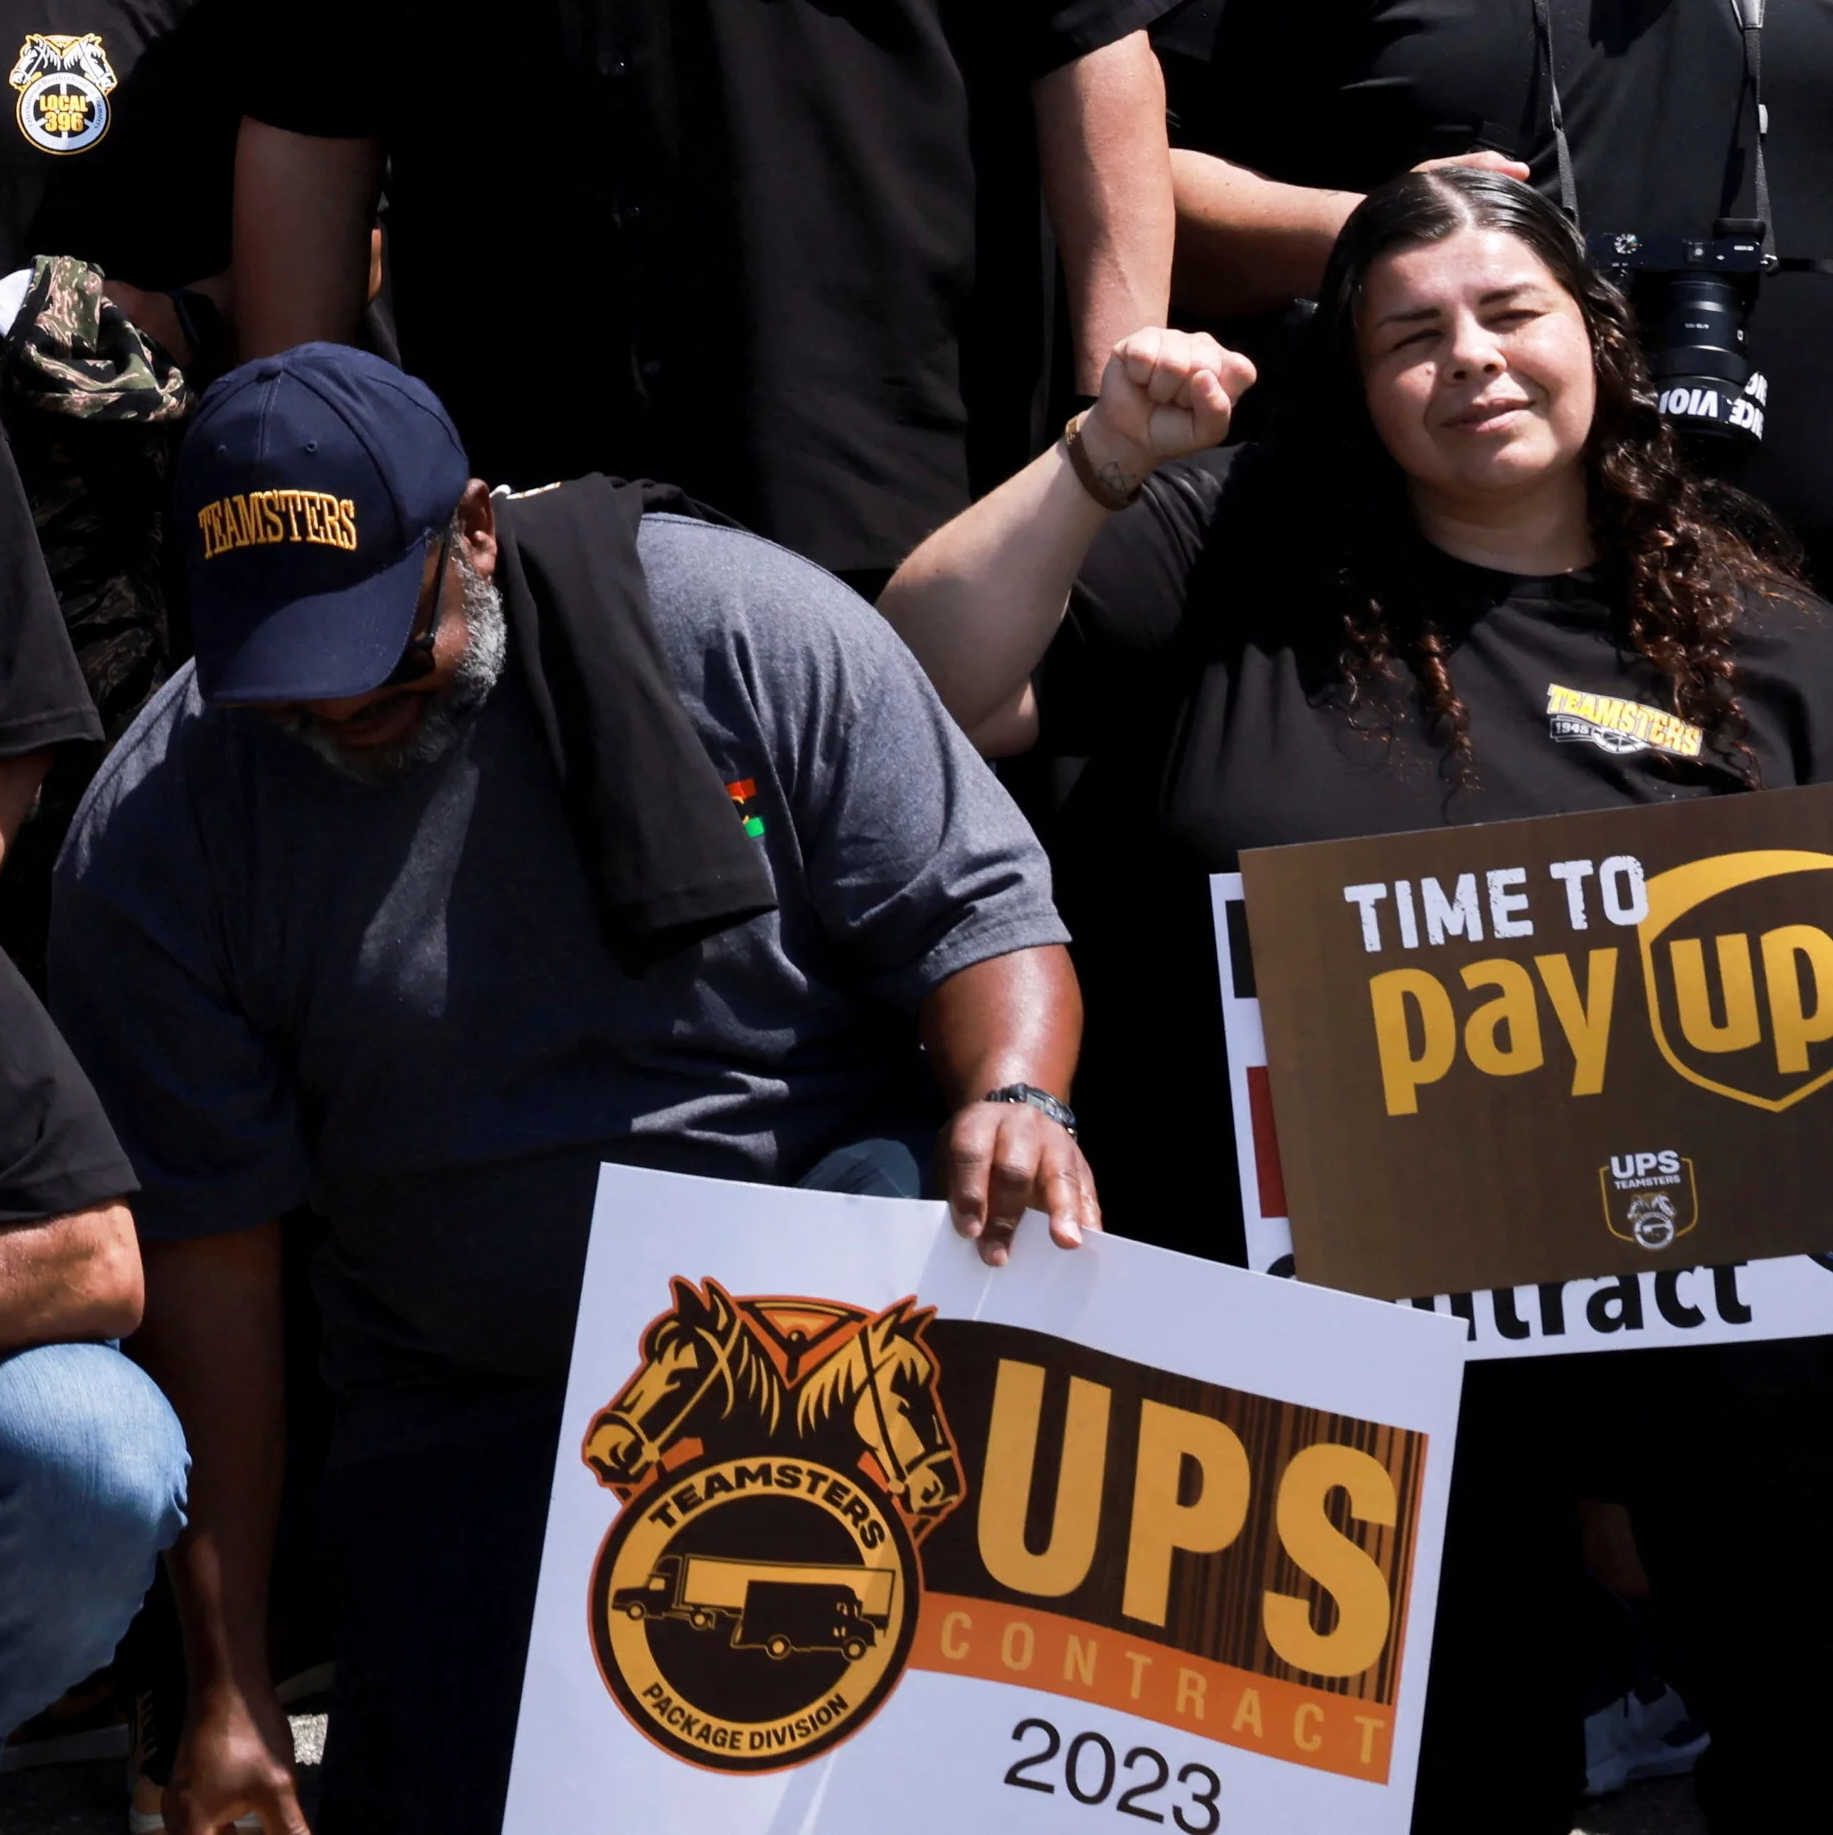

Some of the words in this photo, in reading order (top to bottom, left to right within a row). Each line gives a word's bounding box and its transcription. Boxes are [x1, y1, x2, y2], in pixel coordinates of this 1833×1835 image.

[39, 95, 88, 112] LOCAL
[45, 112, 84, 132] 396
[198, 489, 357, 559] TEAMSTERS
[1548, 683, 1702, 756] TEAMSTERS
[1344, 866, 1534, 952] TIME
[1550, 855, 1650, 931] TO
[1369, 947, 1618, 1116] pay
[1669, 922, 1833, 1073] up
[1611, 1150, 1681, 1179] UPS
[1614, 1176, 1681, 1190] TEAMSTERS
[648, 1463, 885, 1549] TEAMSTERS
[977, 1358, 1397, 1678] UPS
[642, 1681, 743, 1749] PACKAGE
[749, 1693, 849, 1750] DIVISION
[940, 1610, 1386, 1764] CONTRACT
[1004, 1718, 1223, 1835] 2023
